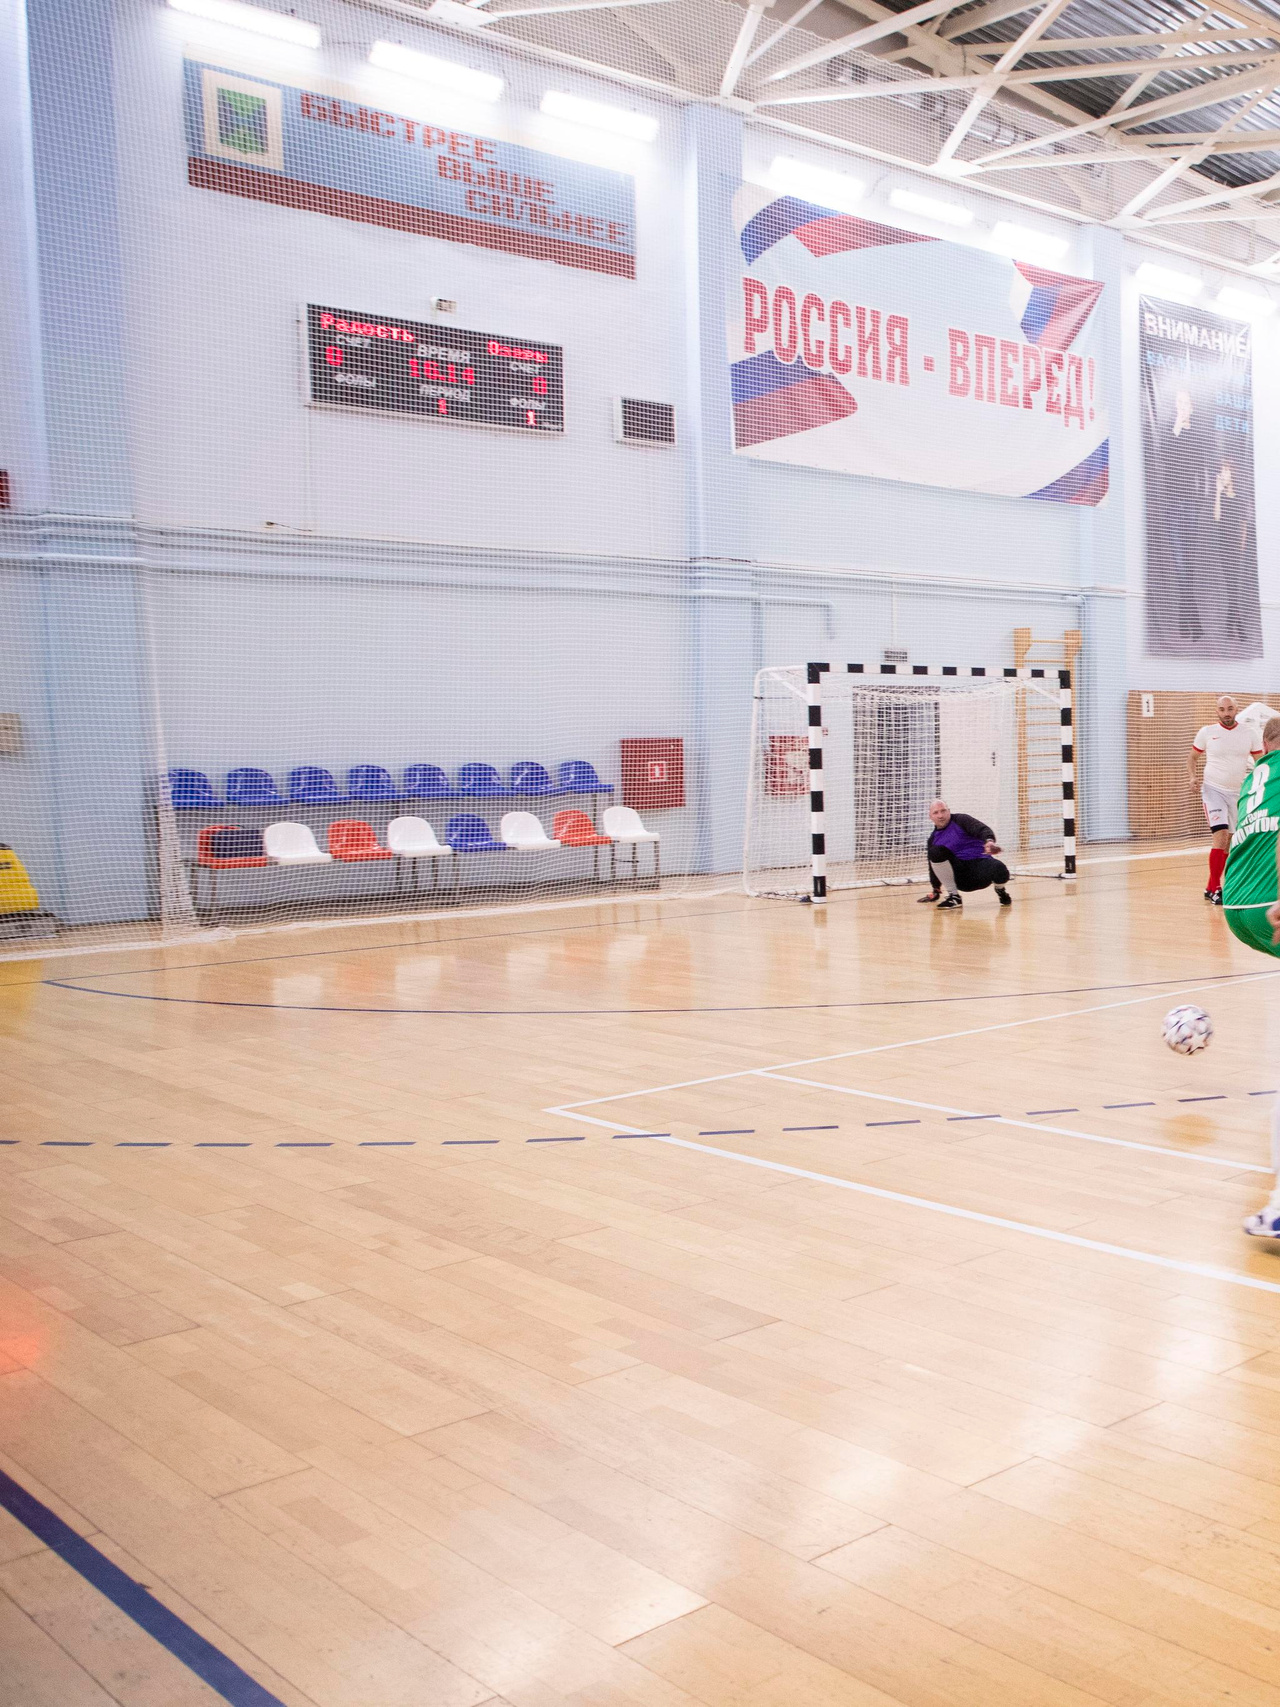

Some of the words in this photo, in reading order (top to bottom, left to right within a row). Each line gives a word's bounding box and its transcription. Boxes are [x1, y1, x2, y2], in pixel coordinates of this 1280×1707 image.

[300, 93, 498, 165] БЫСТРЕЕ
[437, 154, 556, 205] ВЫШЕ
[465, 189, 630, 247] СИЛЬНЕЕ
[320, 312, 415, 342] Радость
[325, 346, 343, 366] 0
[418, 344, 470, 363] ВРЕМЯ
[742, 276, 911, 386] РОССИЯ
[948, 327, 1097, 431] ВПЕРЕД!
[526, 409, 537, 426] 1
